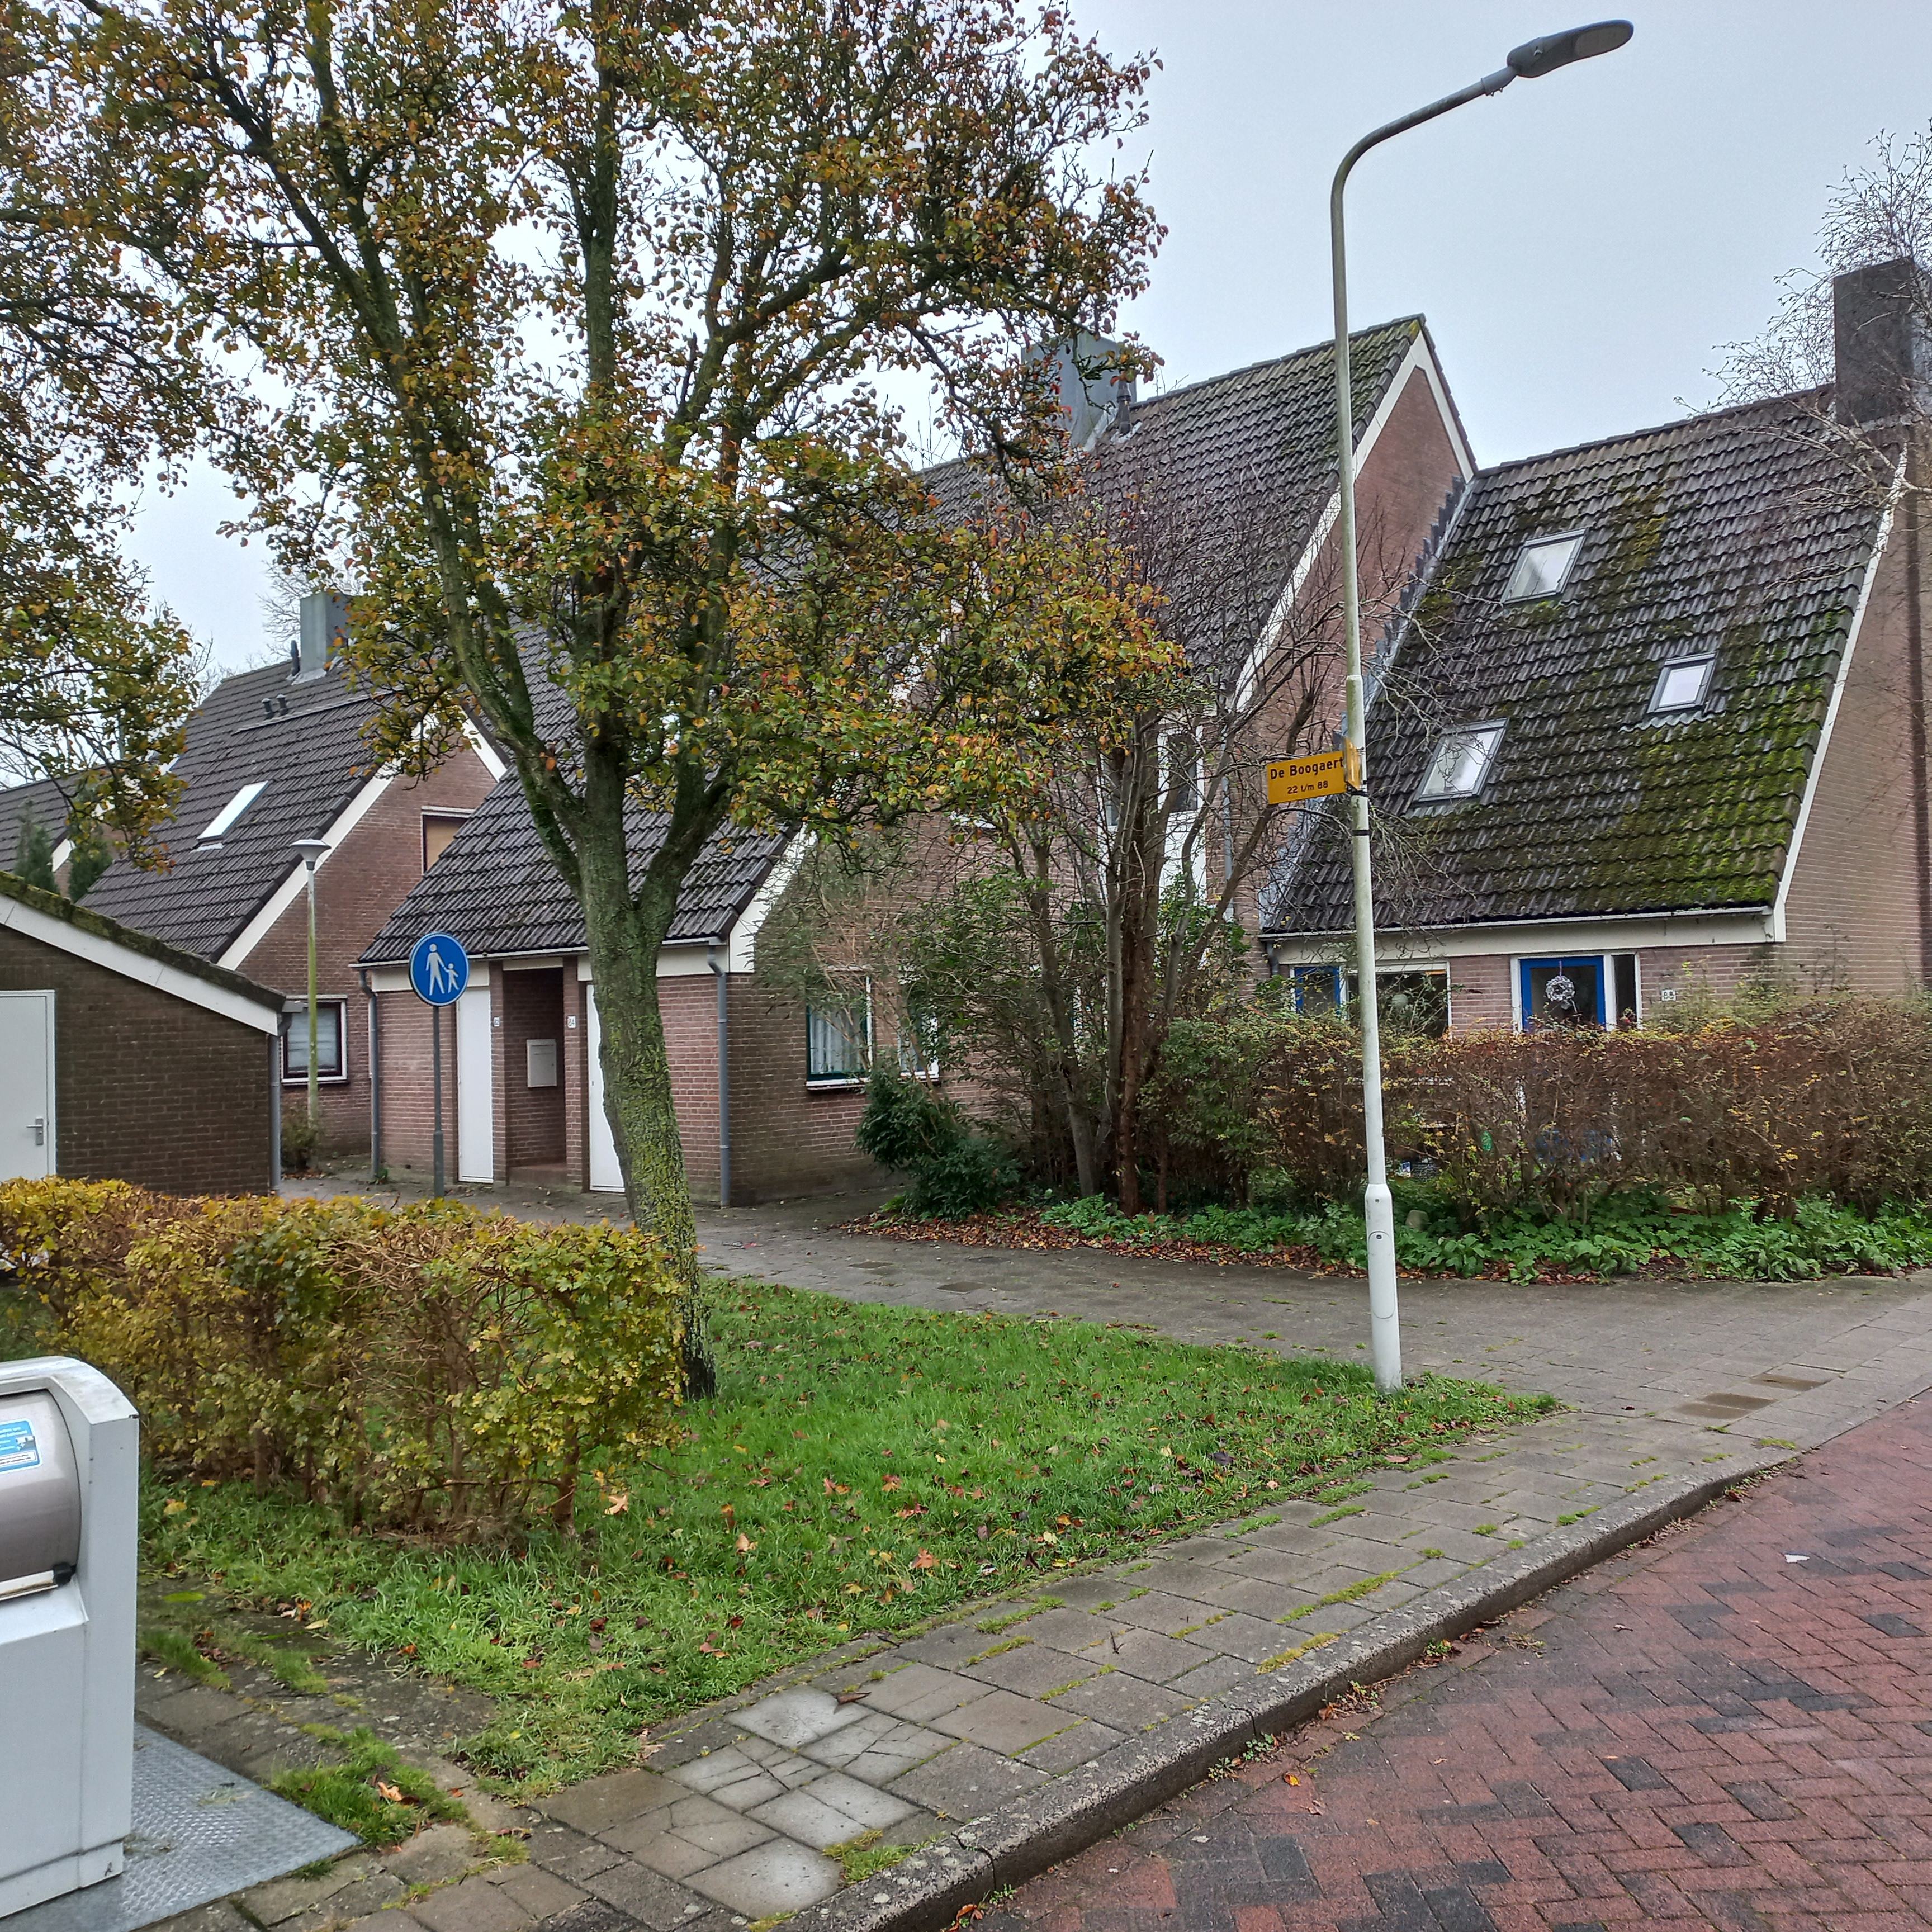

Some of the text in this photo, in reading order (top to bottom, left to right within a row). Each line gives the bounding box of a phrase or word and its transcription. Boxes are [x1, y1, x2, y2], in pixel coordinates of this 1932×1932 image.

[1270, 756, 1343, 779] De Boogaert
[1287, 780, 1329, 794] 22 t/m 88
